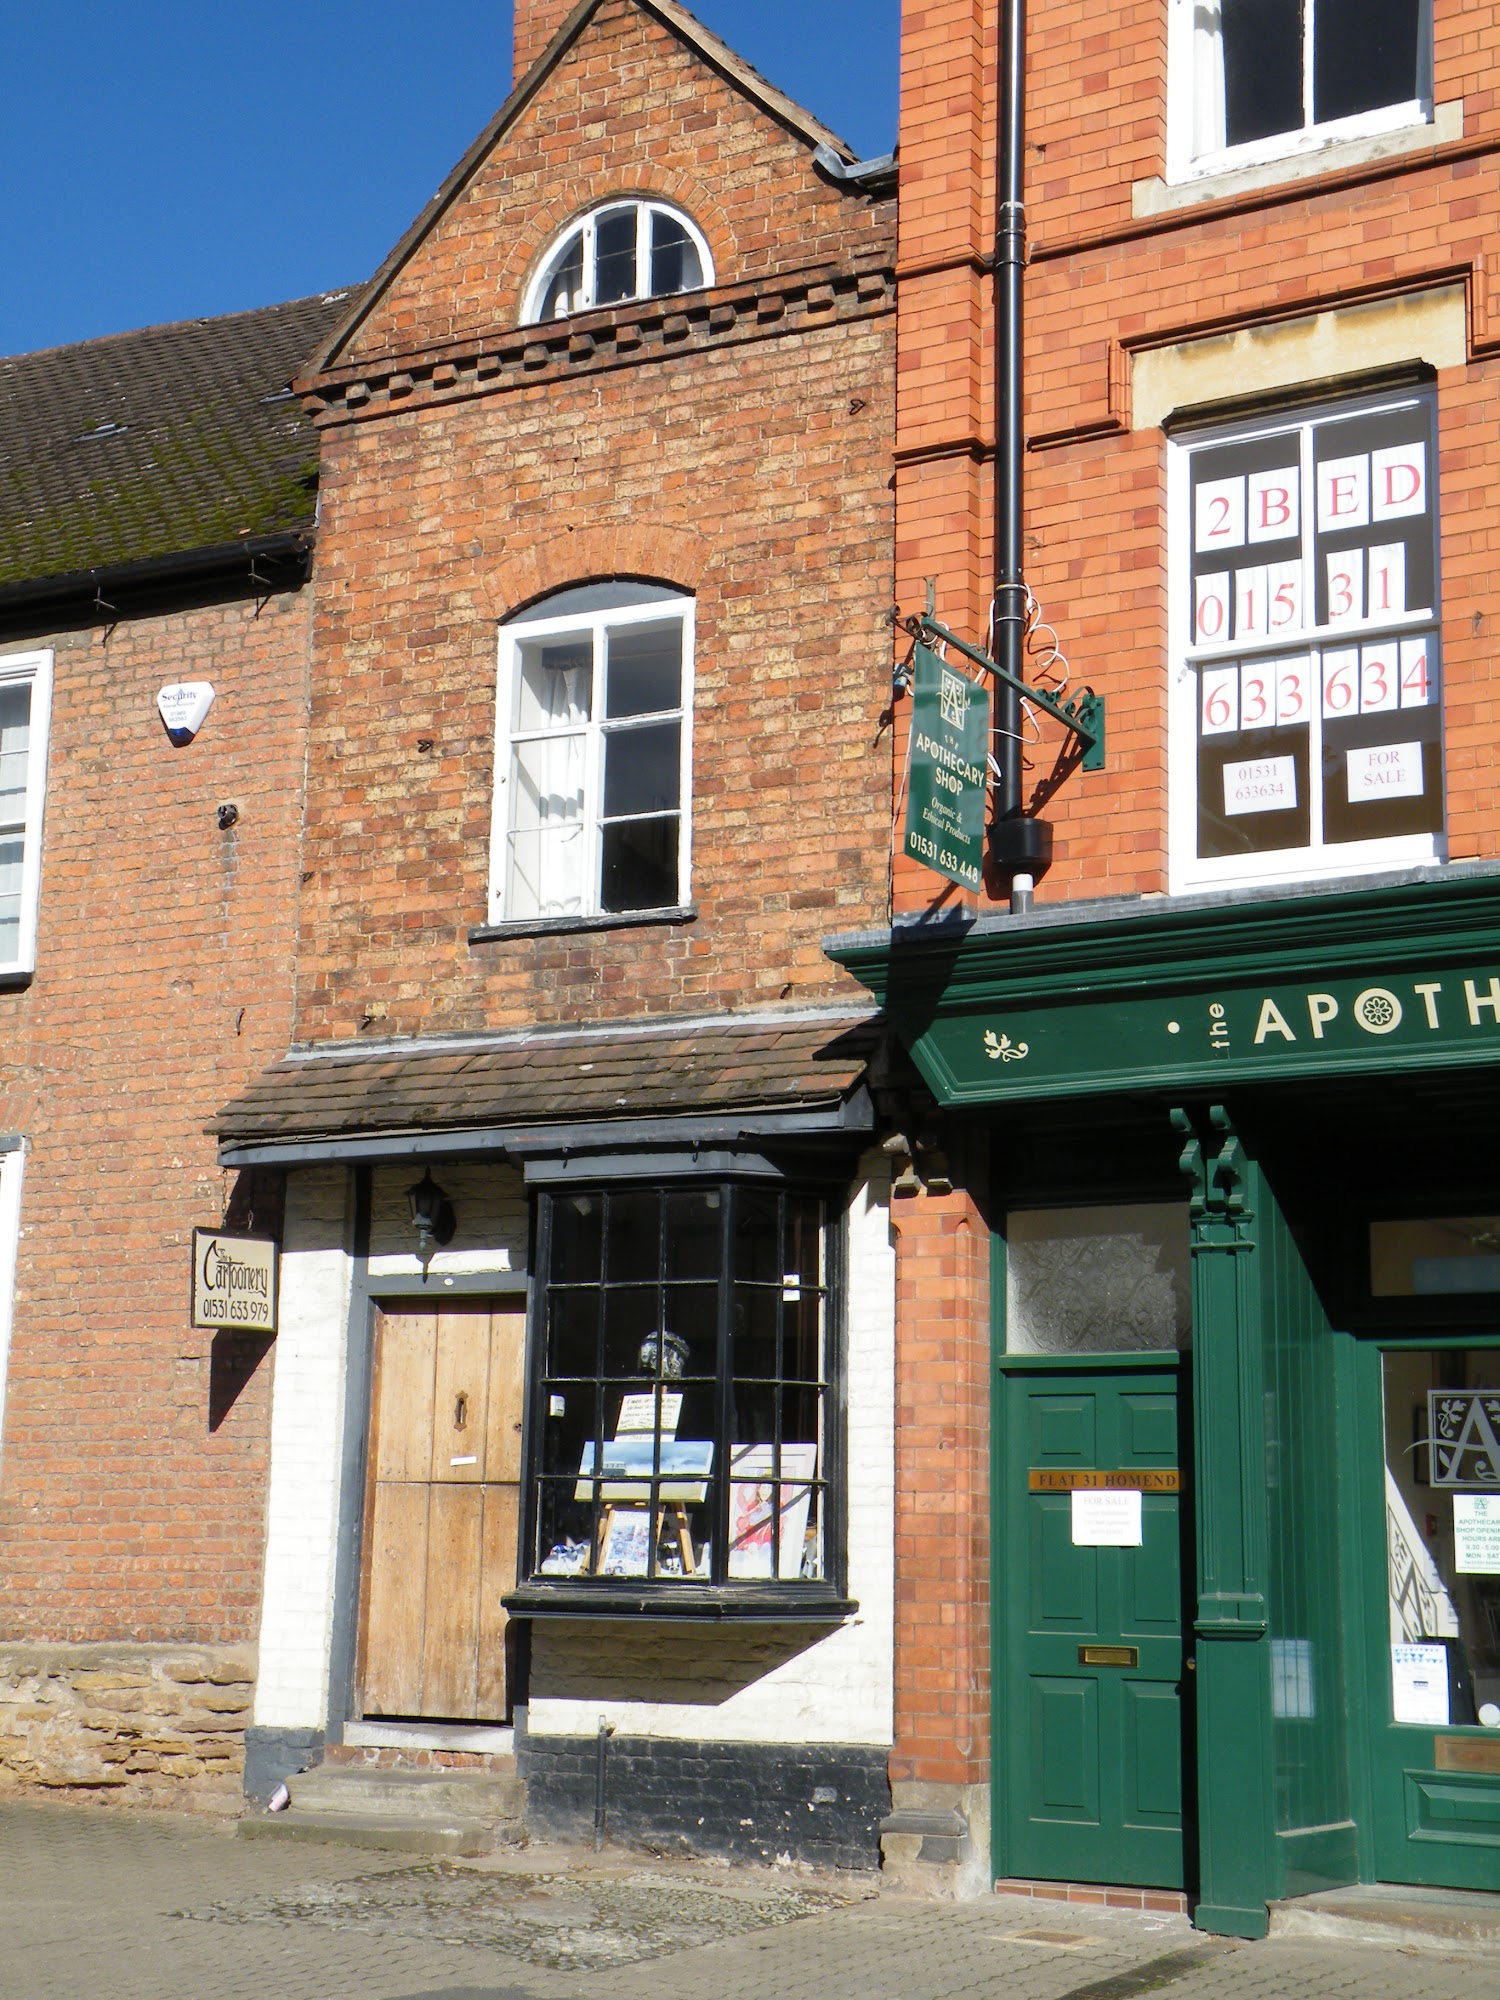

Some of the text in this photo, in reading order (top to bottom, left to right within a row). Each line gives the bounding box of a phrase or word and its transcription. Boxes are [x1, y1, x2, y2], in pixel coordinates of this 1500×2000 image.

[1206, 496, 1232, 536] 2
[1198, 567, 1392, 637] 01531
[944, 734, 959, 751] THE
[916, 732, 984, 788] APOTHECARY
[1369, 750, 1400, 766] FOR
[936, 766, 963, 796] SHOP
[1238, 764, 1277, 781] 01531
[1364, 769, 1406, 786] SALE
[1236, 783, 1284, 800] 633634
[932, 796, 962, 824] Organic &
[922, 808, 970, 845] Ethical Products
[910, 832, 978, 884] 01531 633 448
[1209, 977, 1500, 1048] the APOTH
[204, 1240, 268, 1298] Cartoonery
[204, 1299, 268, 1322] 01531 633 979
[1040, 1474, 1176, 1486] FLAT 31 HOMEND
[1084, 1496, 1128, 1505] FOR SALE
